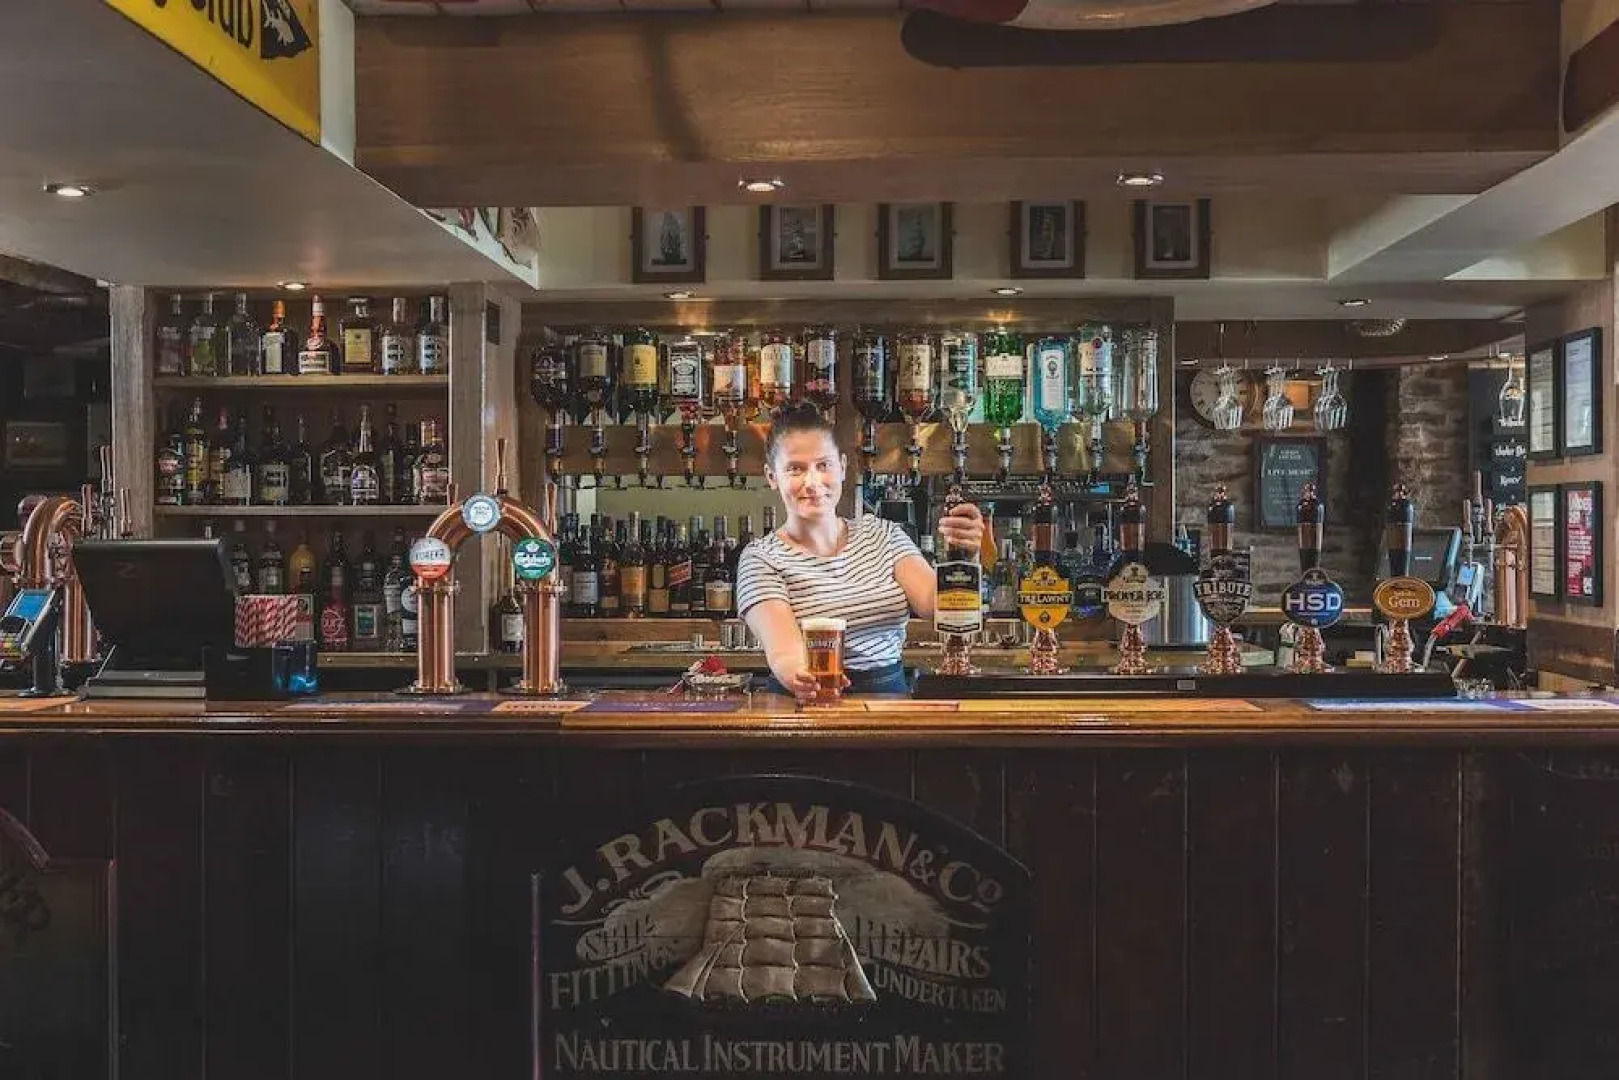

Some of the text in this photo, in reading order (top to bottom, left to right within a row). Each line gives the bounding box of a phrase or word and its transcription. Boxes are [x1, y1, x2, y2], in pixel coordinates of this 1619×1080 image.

[1194, 582, 1251, 597] TRIBUTE
[1286, 592, 1341, 611] HSD
[1388, 596, 1421, 608] Gem
[853, 914, 992, 978] REPAIRS
[874, 962, 1008, 1013] UNDERTAKEN
[555, 1032, 1004, 1074] NAUTICAL INSTRUMENT MAKER
